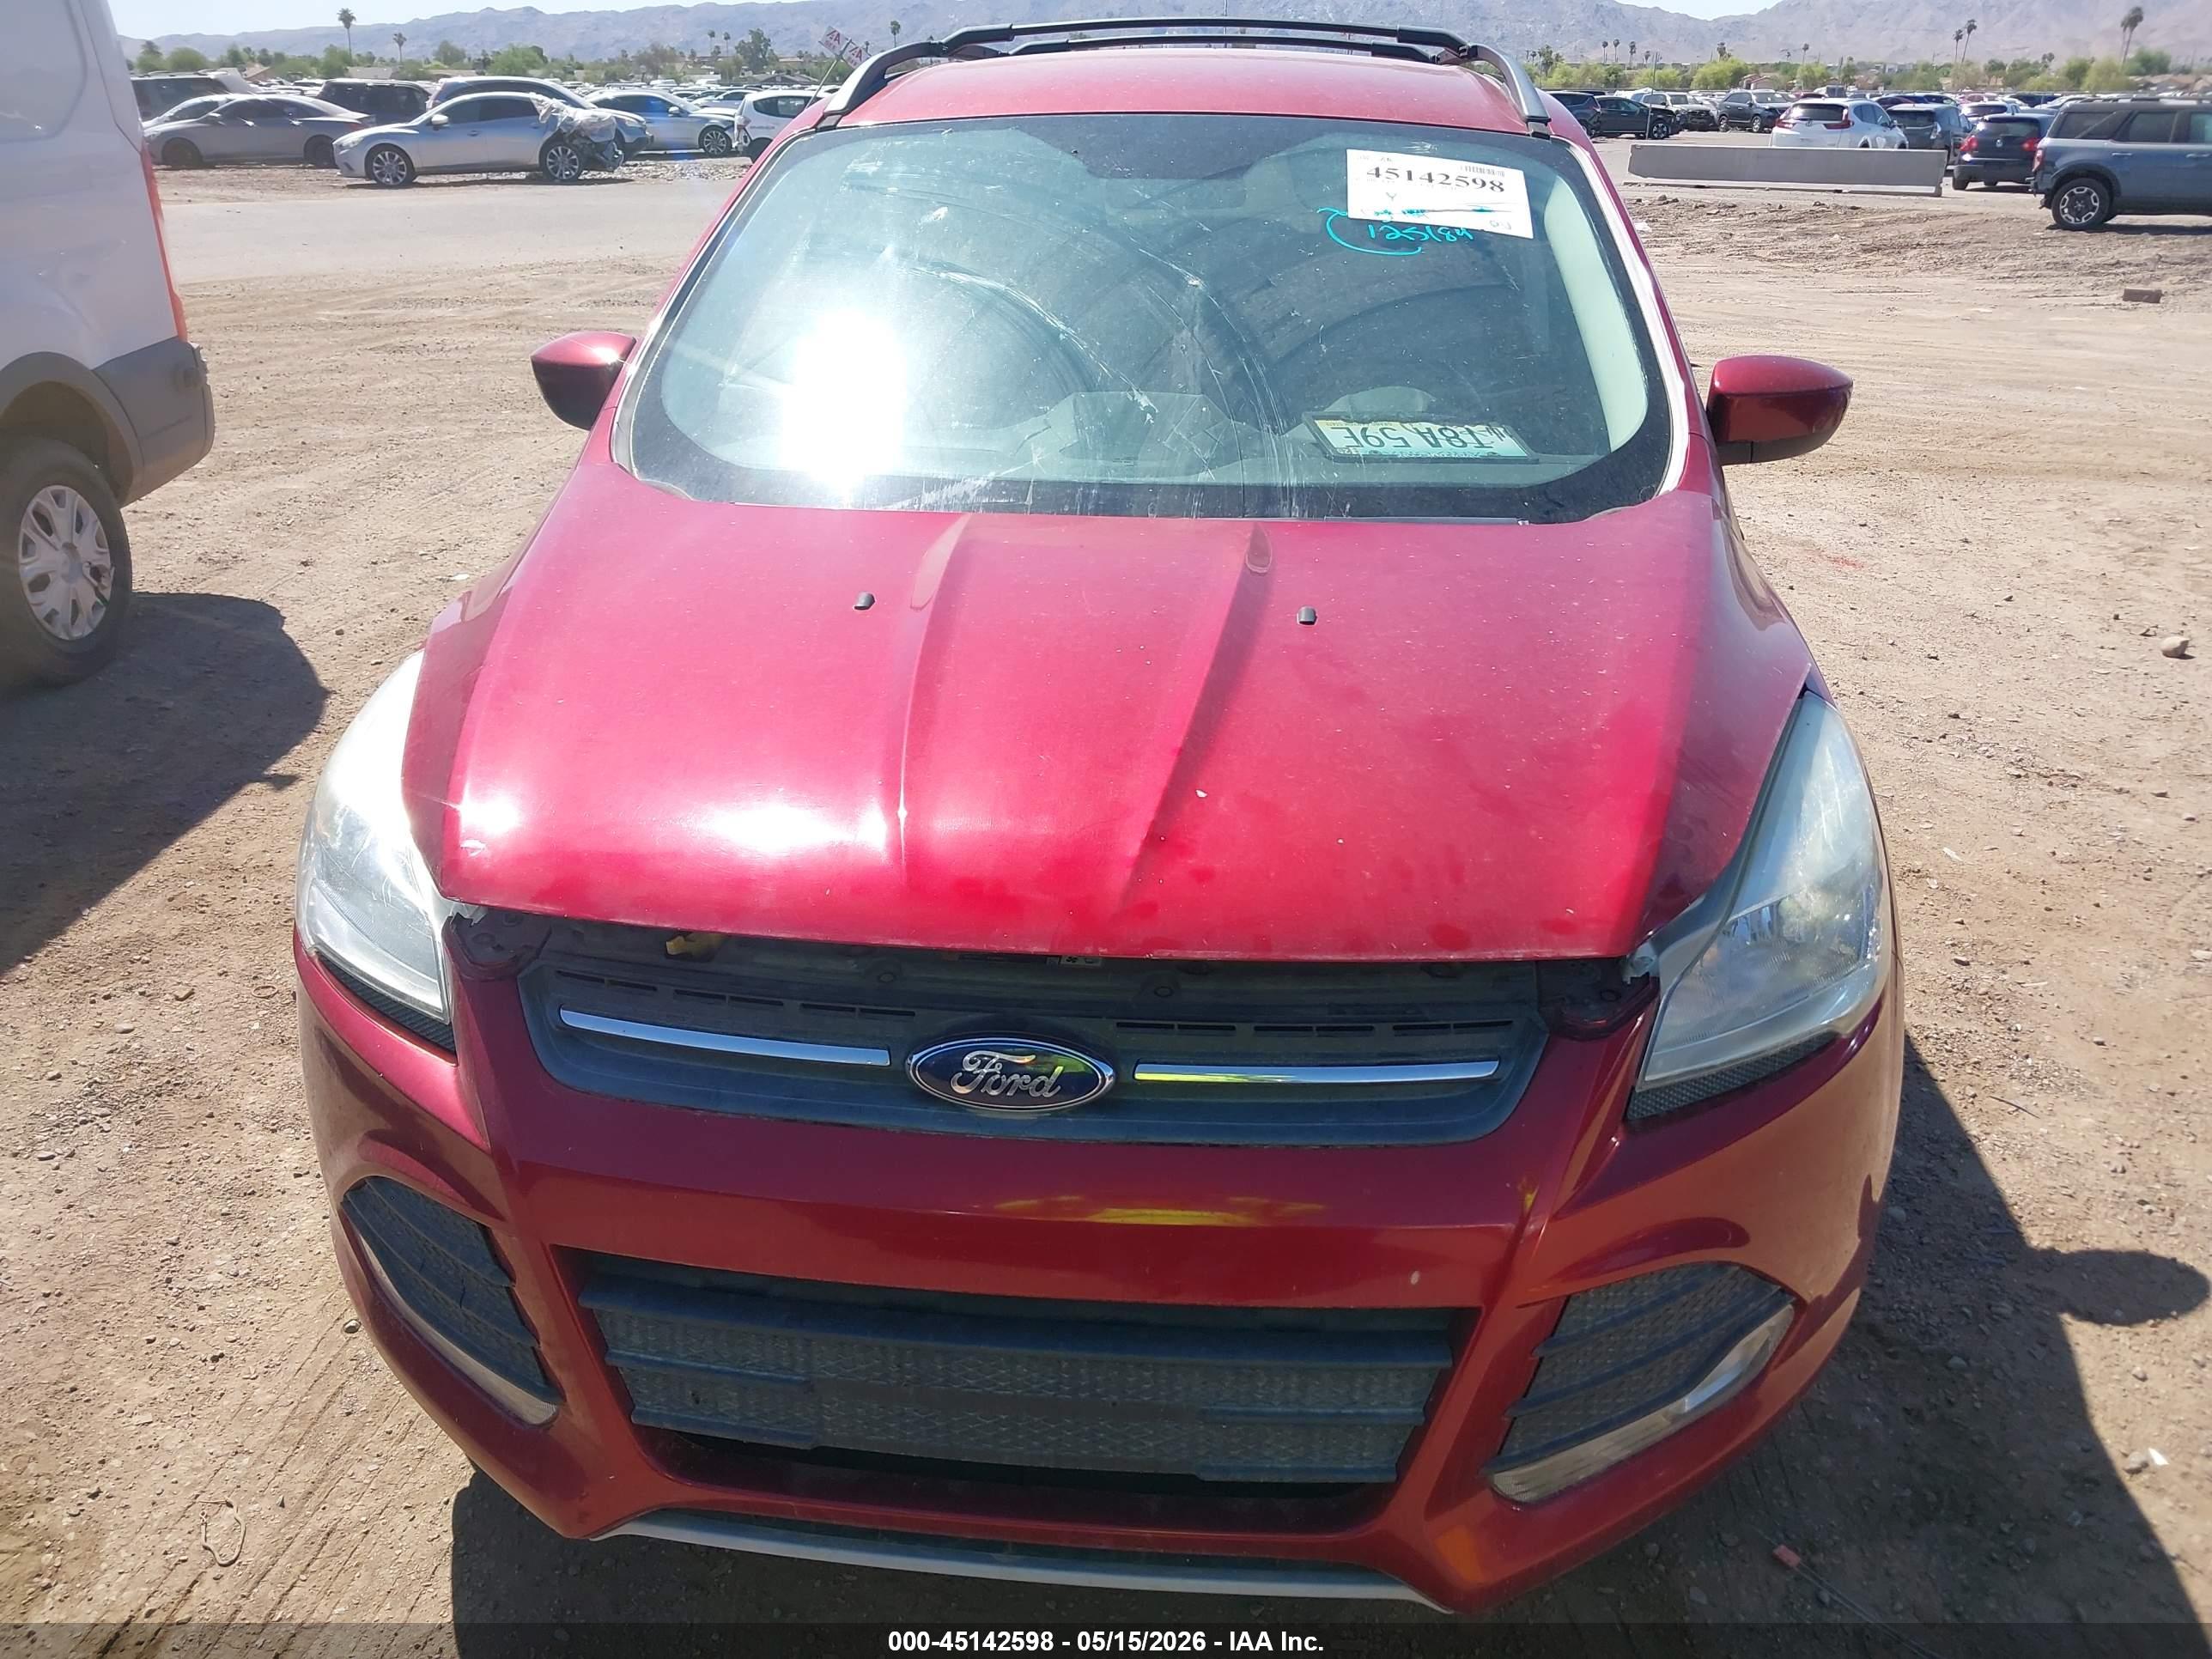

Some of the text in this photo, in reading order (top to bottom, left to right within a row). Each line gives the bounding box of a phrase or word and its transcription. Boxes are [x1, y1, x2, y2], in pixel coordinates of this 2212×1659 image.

[1366, 166, 1505, 193] 45142598
[1330, 427, 1413, 448] 59E
[951, 1050, 1064, 1097] Ford
